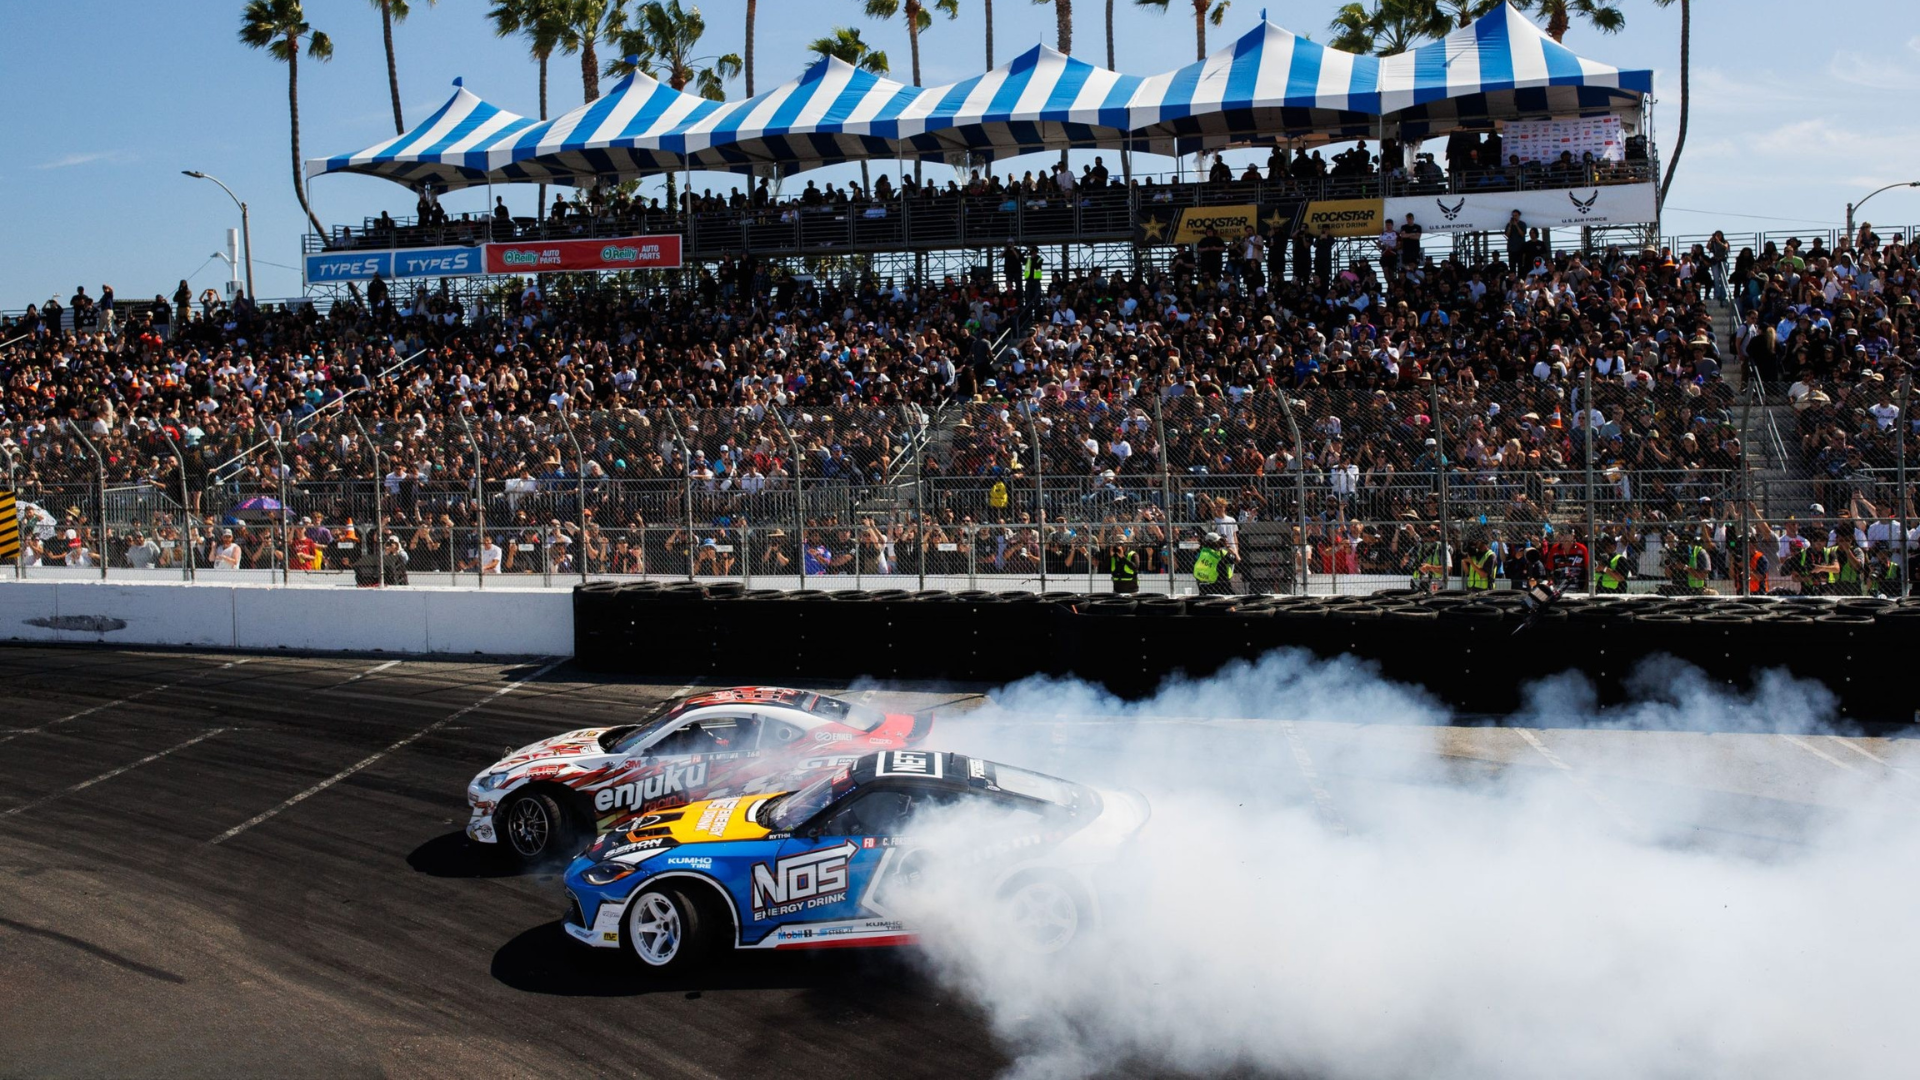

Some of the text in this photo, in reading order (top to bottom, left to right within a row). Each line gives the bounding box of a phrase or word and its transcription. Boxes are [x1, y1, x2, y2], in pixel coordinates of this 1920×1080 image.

[1186, 216, 1248, 228] ROCKSTAR
[1311, 210, 1374, 223] ROCKSTAR
[602, 246, 637, 261] O'Reilly
[641, 245, 659, 253] AUTO
[504, 250, 539, 265] O'Reilly
[639, 252, 660, 260] PARTS
[624, 760, 641, 769] 3M
[594, 761, 707, 812] enjuku
[863, 838, 875, 848] FD
[753, 847, 853, 909] NOS
[754, 892, 846, 921] ENERGY DRINK
[778, 931, 803, 940] Mobil
